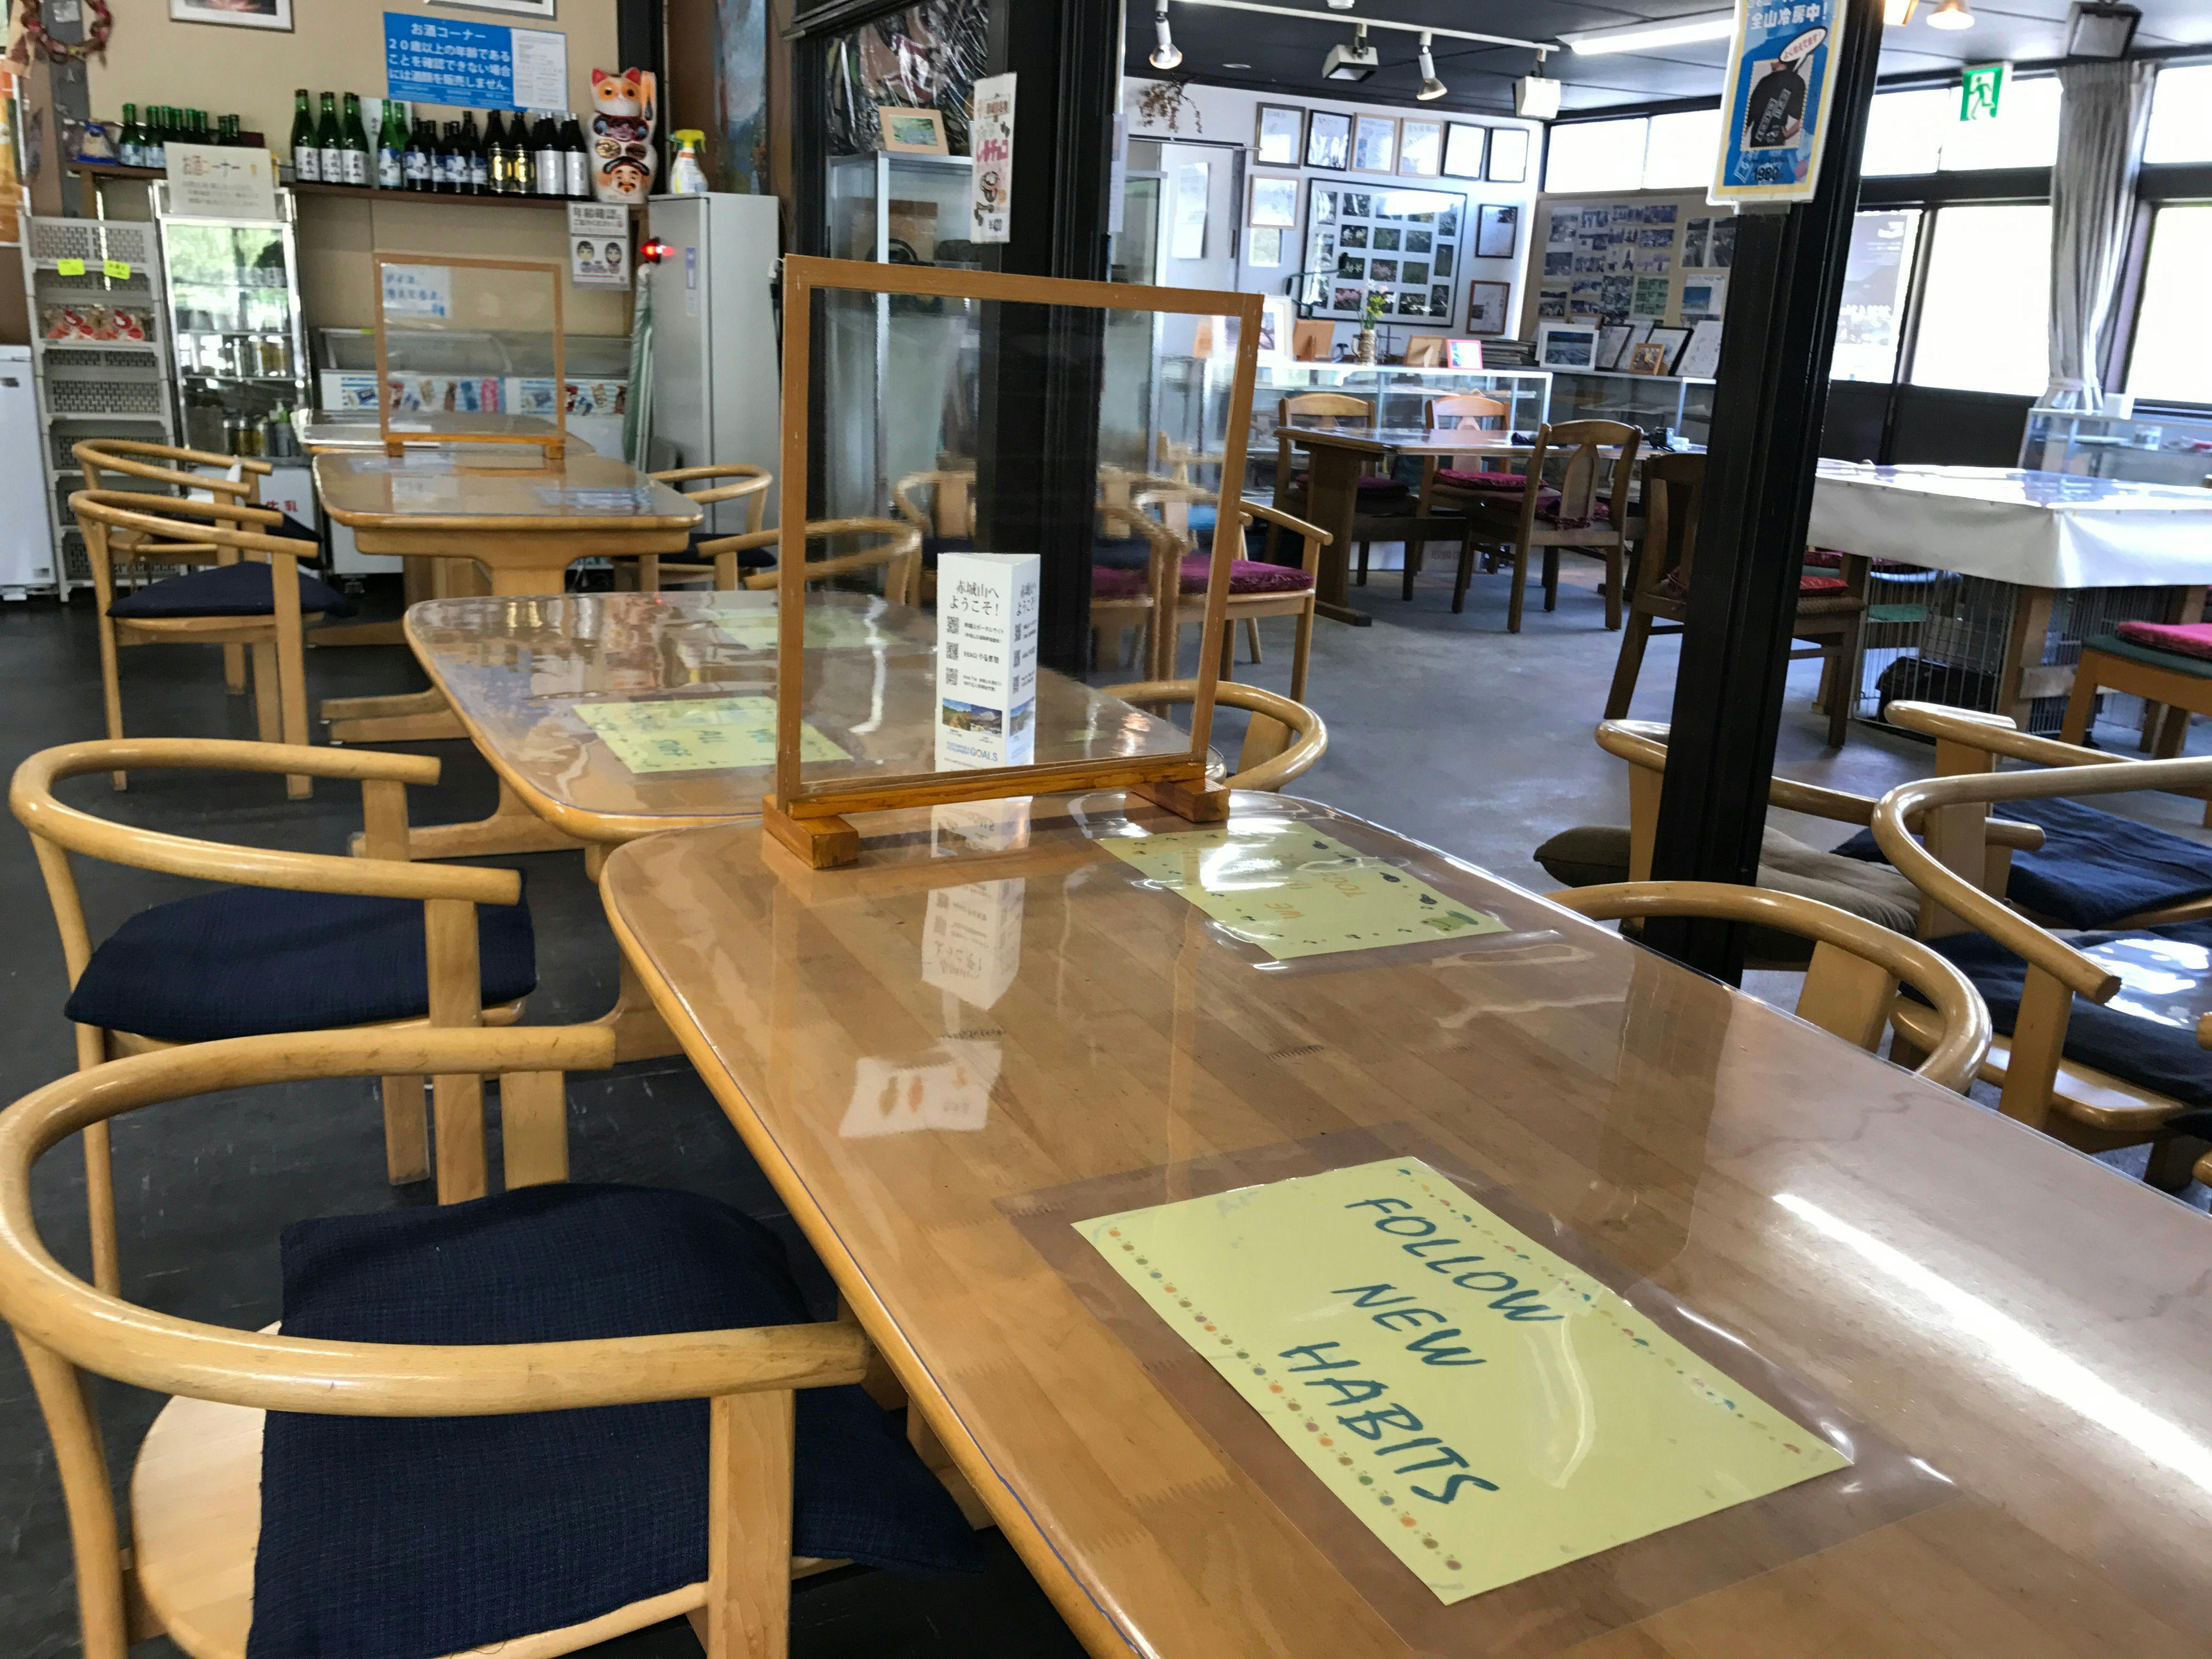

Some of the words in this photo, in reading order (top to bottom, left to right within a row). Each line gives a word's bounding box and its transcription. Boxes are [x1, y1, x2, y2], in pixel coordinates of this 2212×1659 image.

[970, 747, 998, 762] GOALS
[1344, 1198, 1566, 1321] FOLLOW
[1330, 1283, 1488, 1365] NEW
[1278, 1341, 1500, 1504] HABITS
